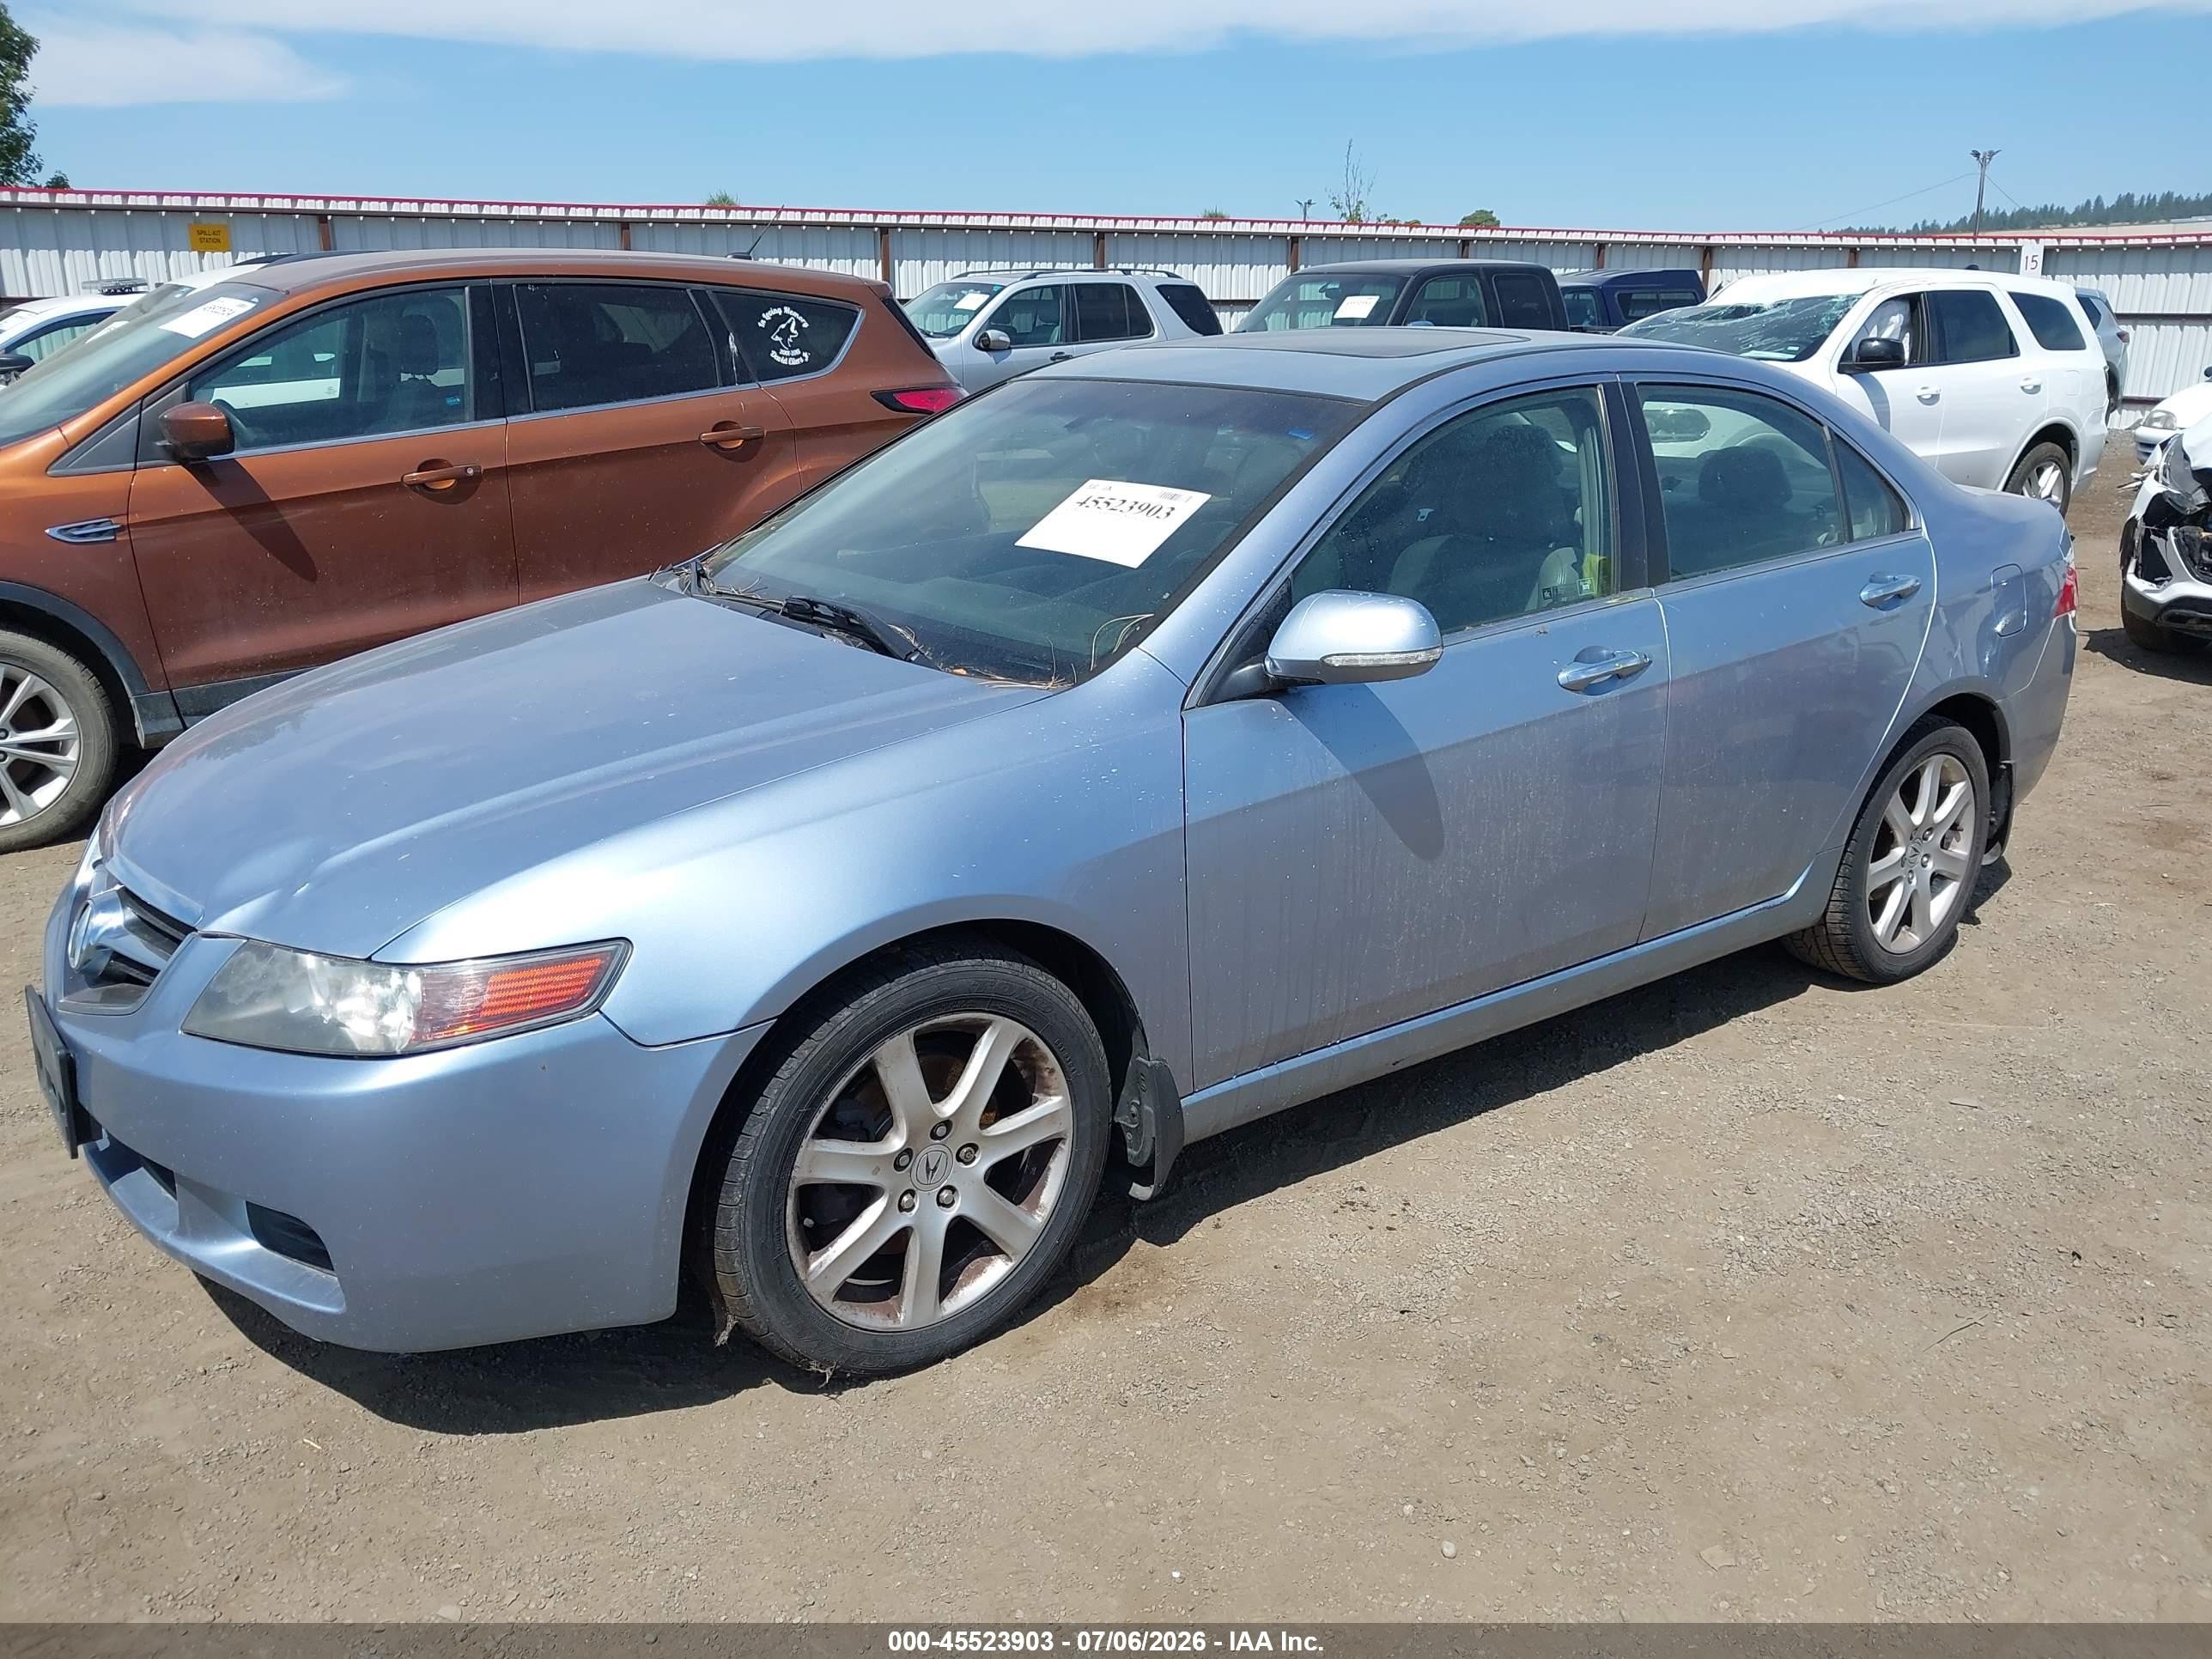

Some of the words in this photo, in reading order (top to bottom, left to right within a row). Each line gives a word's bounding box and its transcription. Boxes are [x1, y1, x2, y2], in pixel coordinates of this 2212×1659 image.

[2025, 254, 2039, 271] 15
[762, 307, 782, 320] Loving
[783, 306, 810, 328] Memory
[1076, 495, 1176, 520] 45523903
